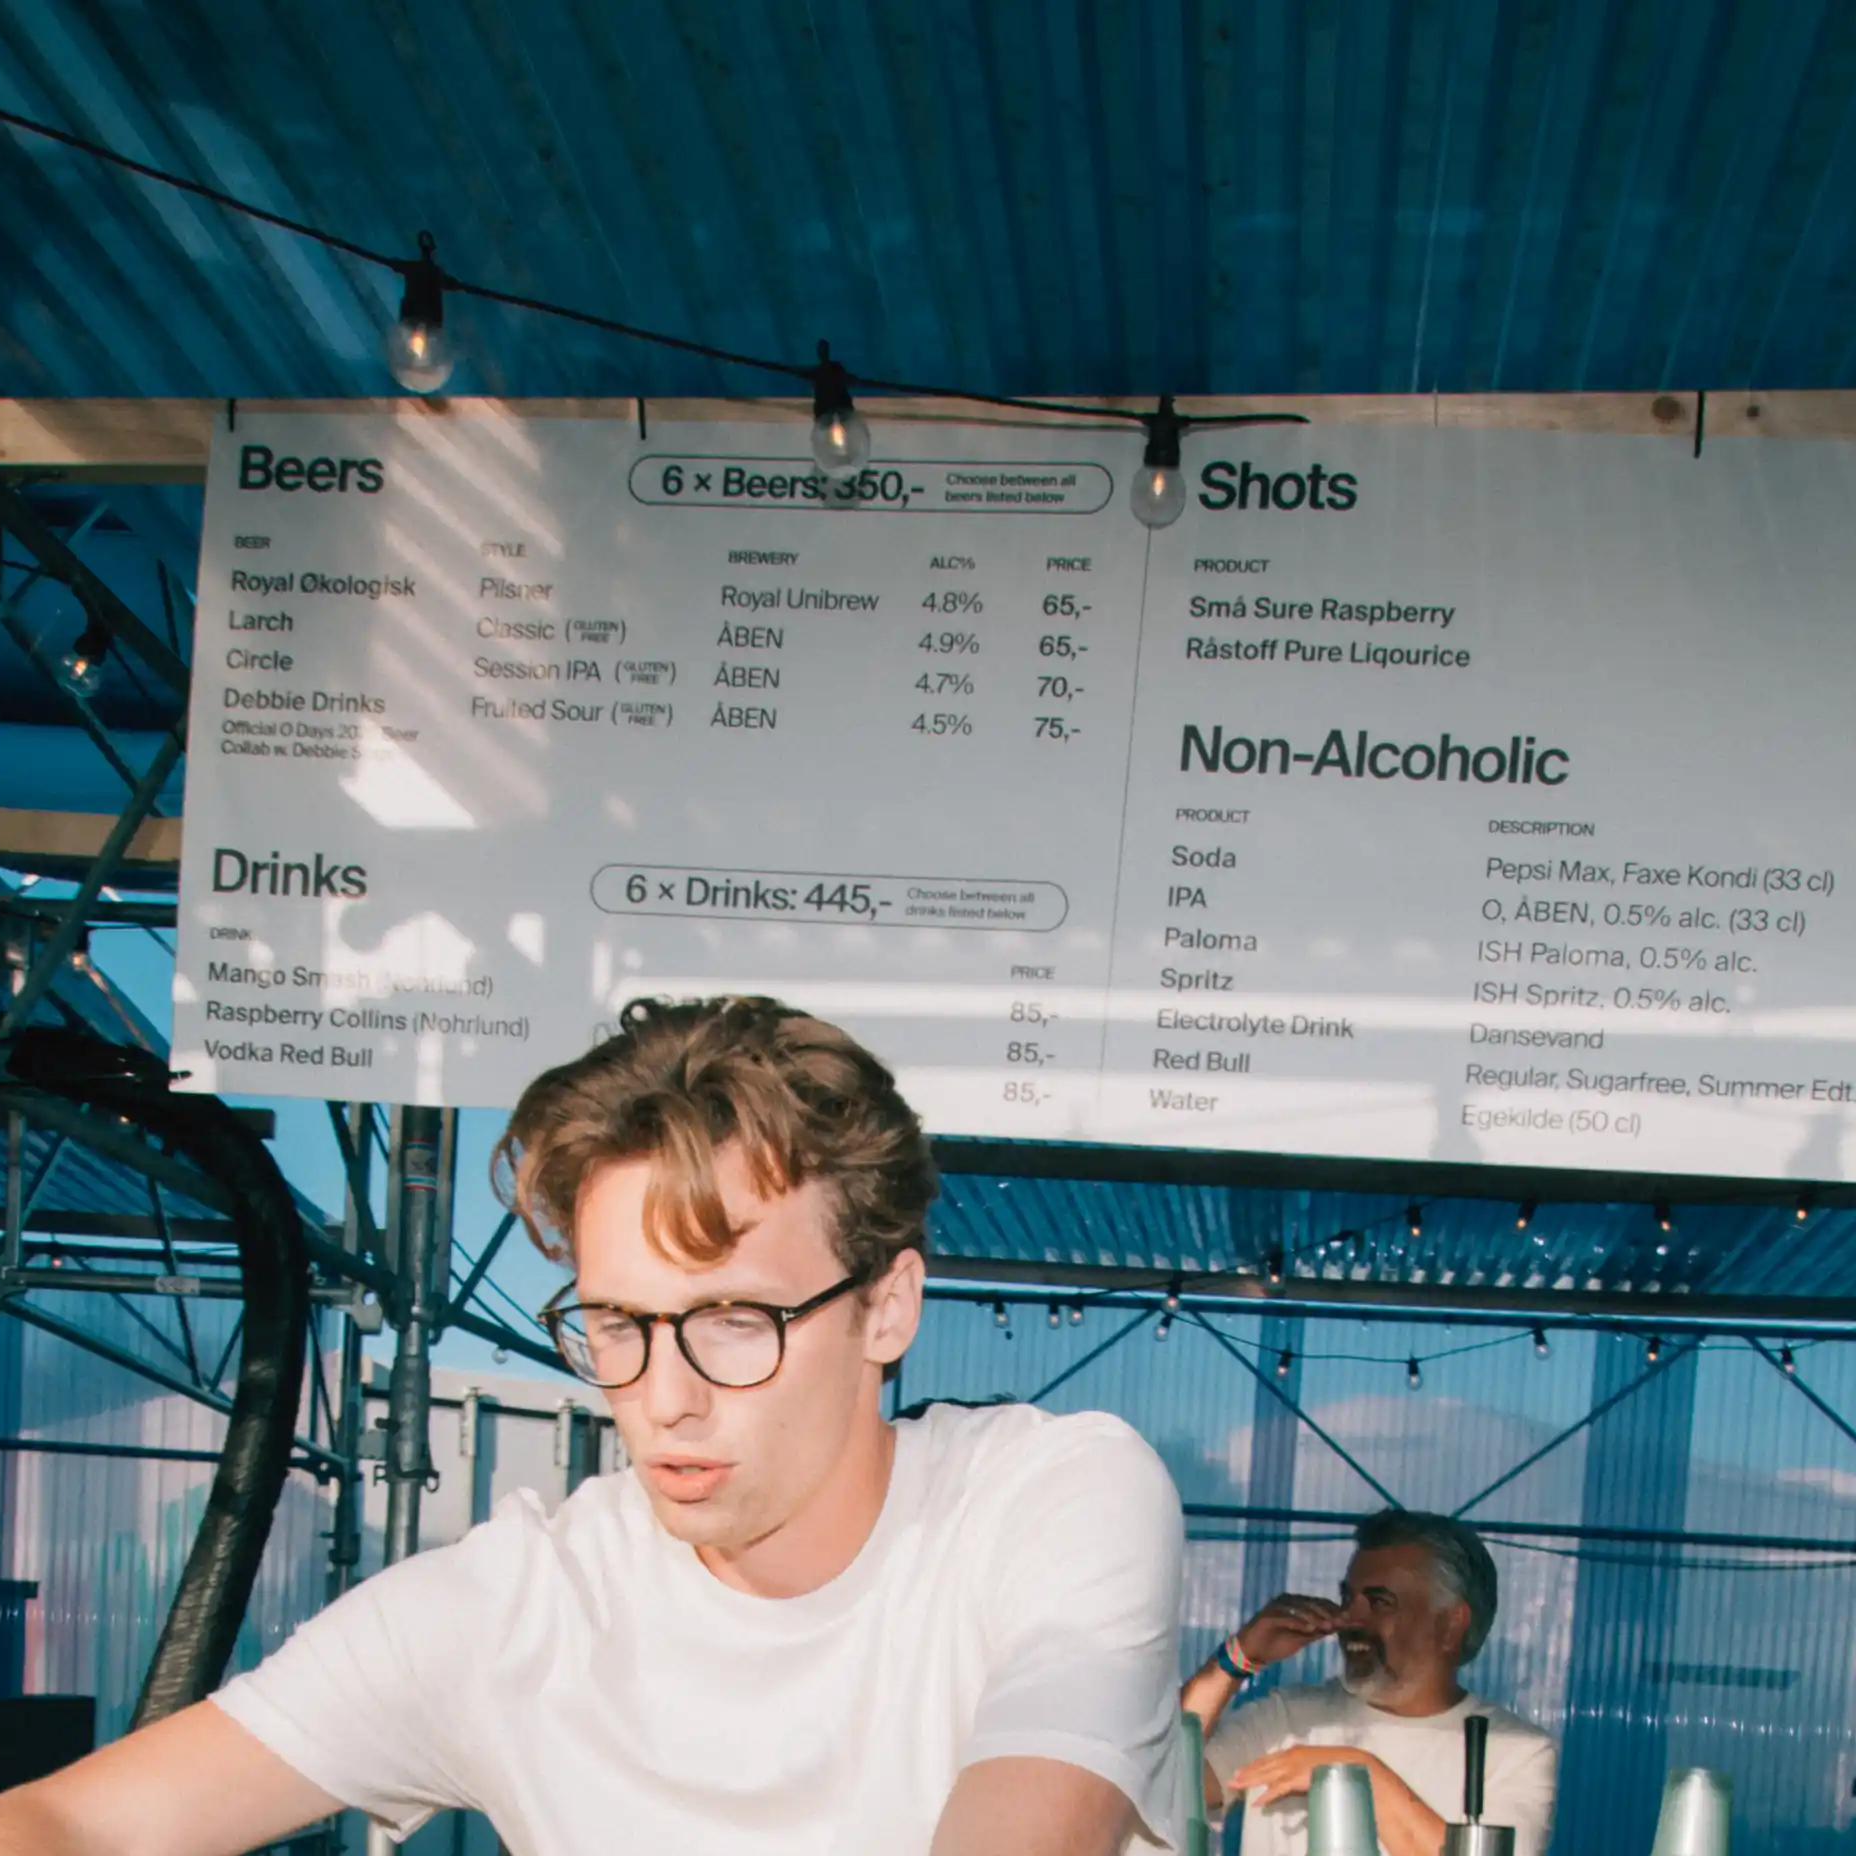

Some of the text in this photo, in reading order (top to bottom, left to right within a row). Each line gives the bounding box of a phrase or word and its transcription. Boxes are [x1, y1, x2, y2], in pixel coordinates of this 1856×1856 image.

[239, 445, 384, 493] Beers
[662, 465, 684, 495] 6
[723, 467, 827, 499] Beers:
[1198, 460, 1358, 511] Shots
[235, 536, 271, 549] BEER
[728, 551, 798, 565] BREWERY
[930, 556, 975, 570] ALC%
[1047, 558, 1092, 572] PRICE
[1193, 559, 1270, 573] PRODUCT
[232, 571, 415, 599] Royal Økologisk
[479, 578, 552, 600] Pilsner
[720, 586, 879, 612] Royal Unibrew
[922, 592, 983, 614] 4.8%
[1043, 595, 1092, 619] 65,-
[228, 610, 293, 632] Larch
[1190, 595, 1455, 629] Små Sure Raspberry
[476, 617, 555, 640] Classic
[717, 621, 784, 649] ÅBEN
[918, 633, 980, 655] 4.9%
[1039, 636, 1088, 661] 65,-
[1186, 636, 1470, 668] Råstoff Pure Liqourice
[226, 649, 293, 671] Circle
[473, 658, 601, 681] Session IPA
[714, 661, 780, 689] ÅBEN
[915, 673, 974, 694] 4.7%
[224, 688, 385, 714] Debbie Drinks
[1037, 677, 1084, 702] 70,-
[471, 697, 603, 722] Fruited Sour
[711, 702, 777, 729] ÅBEN
[911, 714, 972, 736] 4.5%
[1034, 718, 1080, 742] 75,-
[1180, 724, 1570, 786] Non-Alcoholic
[1488, 820, 1595, 837] DESCRIPTION
[1171, 845, 1236, 868] Soda
[212, 848, 368, 898] Drinks
[1486, 857, 1835, 896] Pepsi Max, Faxe Kondi (33 cl)
[626, 875, 647, 902] 6
[686, 877, 797, 911] Drinks:
[804, 883, 893, 921] 445,-
[1167, 886, 1207, 908] IPA
[1164, 927, 1257, 952] Paloma
[1010, 965, 1055, 979] PRICE
[1160, 967, 1234, 992] Spritz
[206, 1000, 530, 1040] Raspberry Collins (Nohrlund)
[1156, 1008, 1354, 1038] Electrolyte Drink
[1470, 1023, 1605, 1050] Dansevand
[204, 1040, 373, 1068] Vodka Red Bull
[1006, 1042, 1054, 1066] 85,-
[1152, 1048, 1250, 1073] Red Bull
[1466, 1063, 1856, 1103] Regular, Sugarfree, Summer Edt.
[1148, 1089, 1218, 1112] Water
